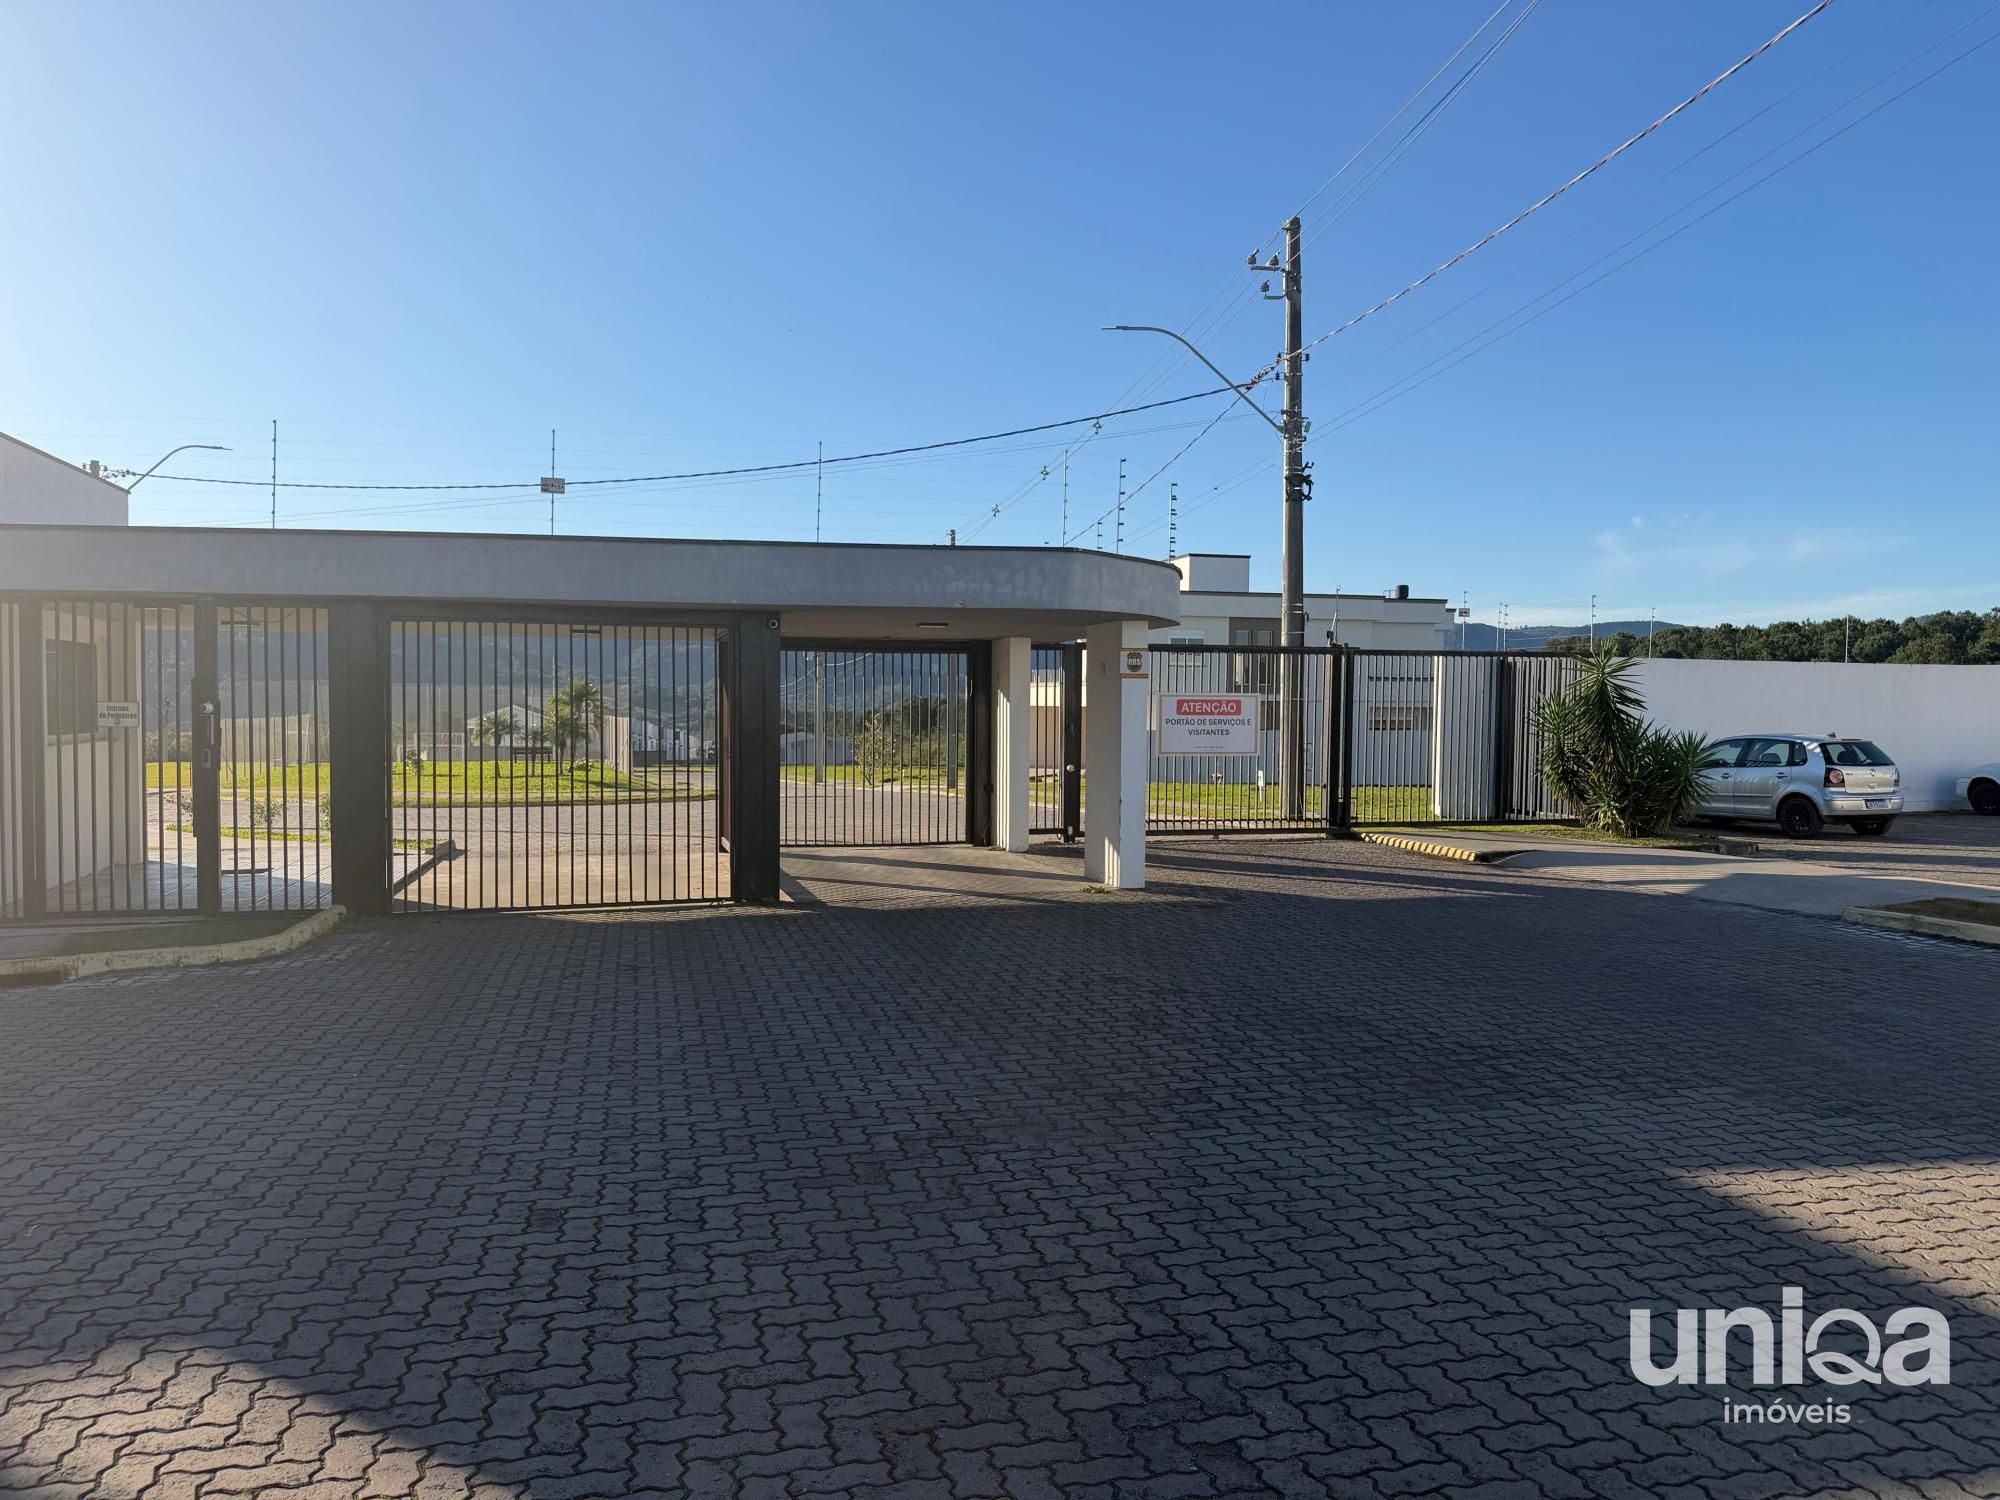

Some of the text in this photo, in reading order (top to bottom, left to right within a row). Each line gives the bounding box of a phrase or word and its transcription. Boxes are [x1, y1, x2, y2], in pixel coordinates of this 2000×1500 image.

[1181, 700, 1237, 715] ATENÇÃO
[1165, 717, 1253, 727] PORTÃO DE SERVIÇOS E
[1188, 728, 1230, 736] VISITANTES
